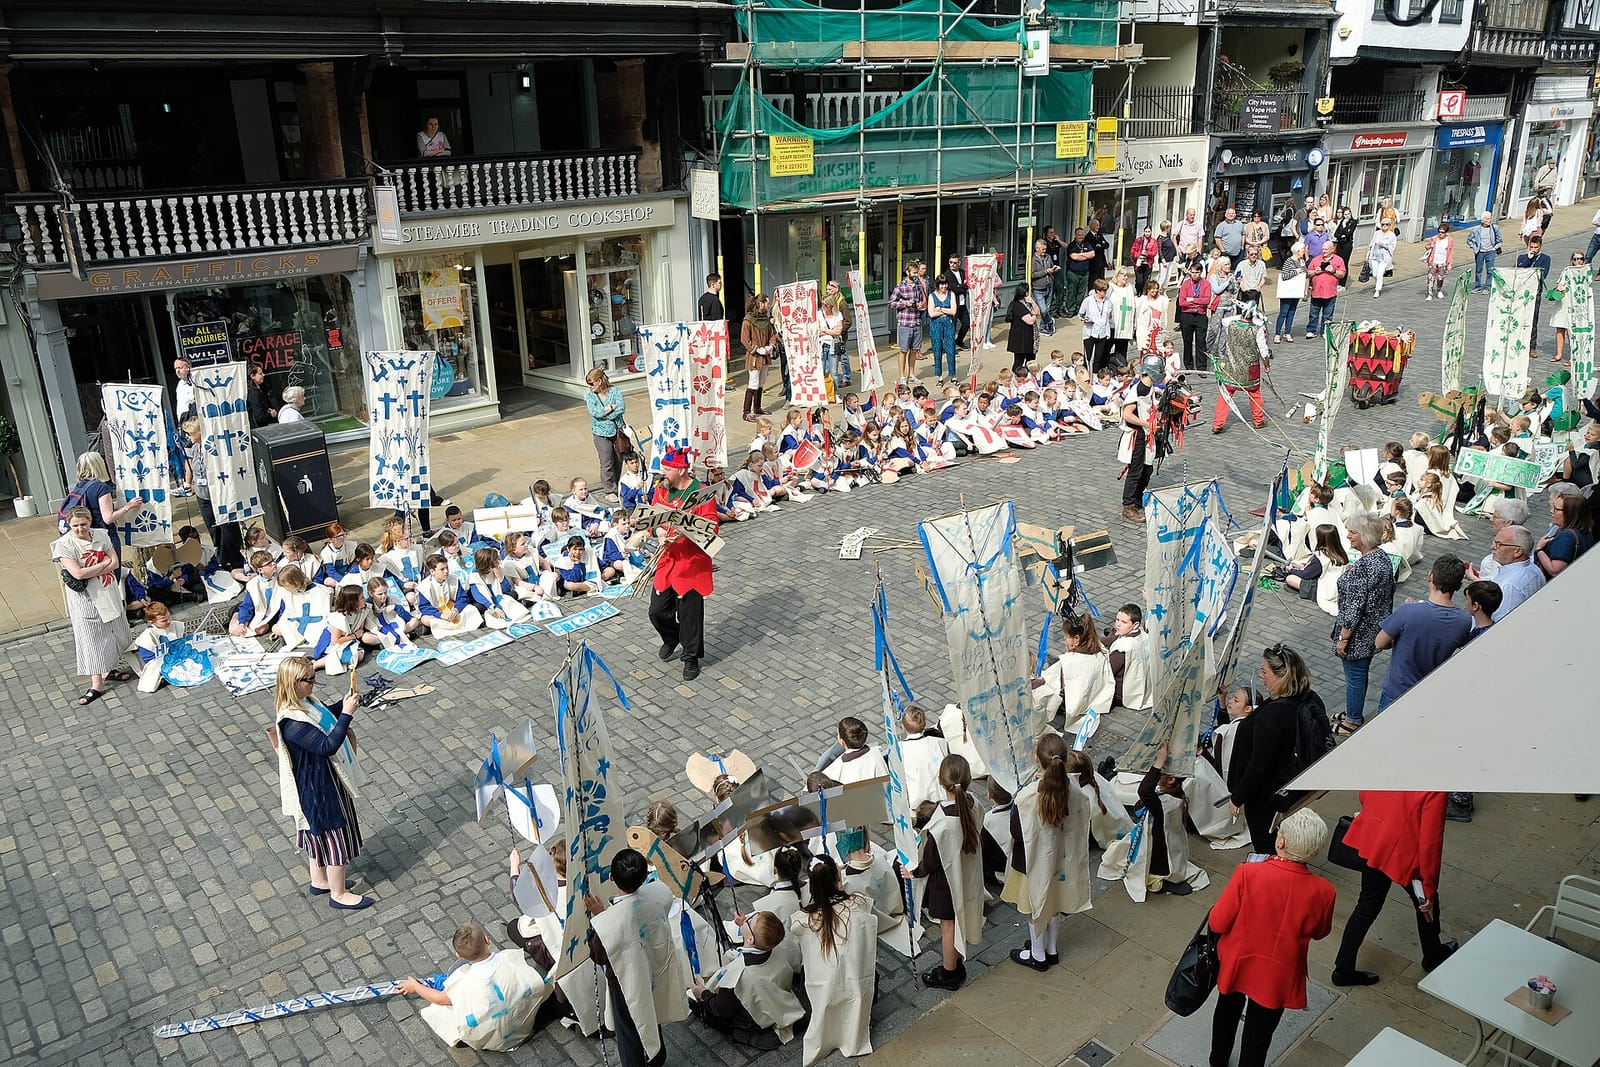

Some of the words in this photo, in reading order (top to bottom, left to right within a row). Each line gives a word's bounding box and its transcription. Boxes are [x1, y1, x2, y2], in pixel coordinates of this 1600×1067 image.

[1248, 99, 1260, 107] City
[1260, 98, 1277, 106] News
[775, 134, 808, 144] WARNING
[1451, 128, 1476, 138] TRESPASS
[1127, 157, 1153, 174] Vegas
[1159, 153, 1184, 169] Nails
[1231, 156, 1244, 167] City
[1245, 155, 1262, 164] News
[1263, 154, 1269, 162] &
[1269, 154, 1285, 165] Vape
[1285, 152, 1297, 161] Hut
[403, 221, 481, 243] STEAMER
[489, 214, 559, 235] TRADING
[568, 206, 654, 228] COOKSHOP
[89, 252, 321, 287] GRAFFICKS
[125, 276, 209, 290] ALTERNATIVE
[215, 270, 270, 282] SNEAKER
[274, 266, 310, 275] STORE
[427, 296, 457, 307] OFFERS
[196, 326, 211, 335] ALL
[181, 333, 227, 346] ENQUIRIES
[242, 333, 300, 354] GARAGE
[188, 349, 226, 360] WILD
[251, 349, 296, 370] SALE
[634, 511, 718, 535] SILENCE
